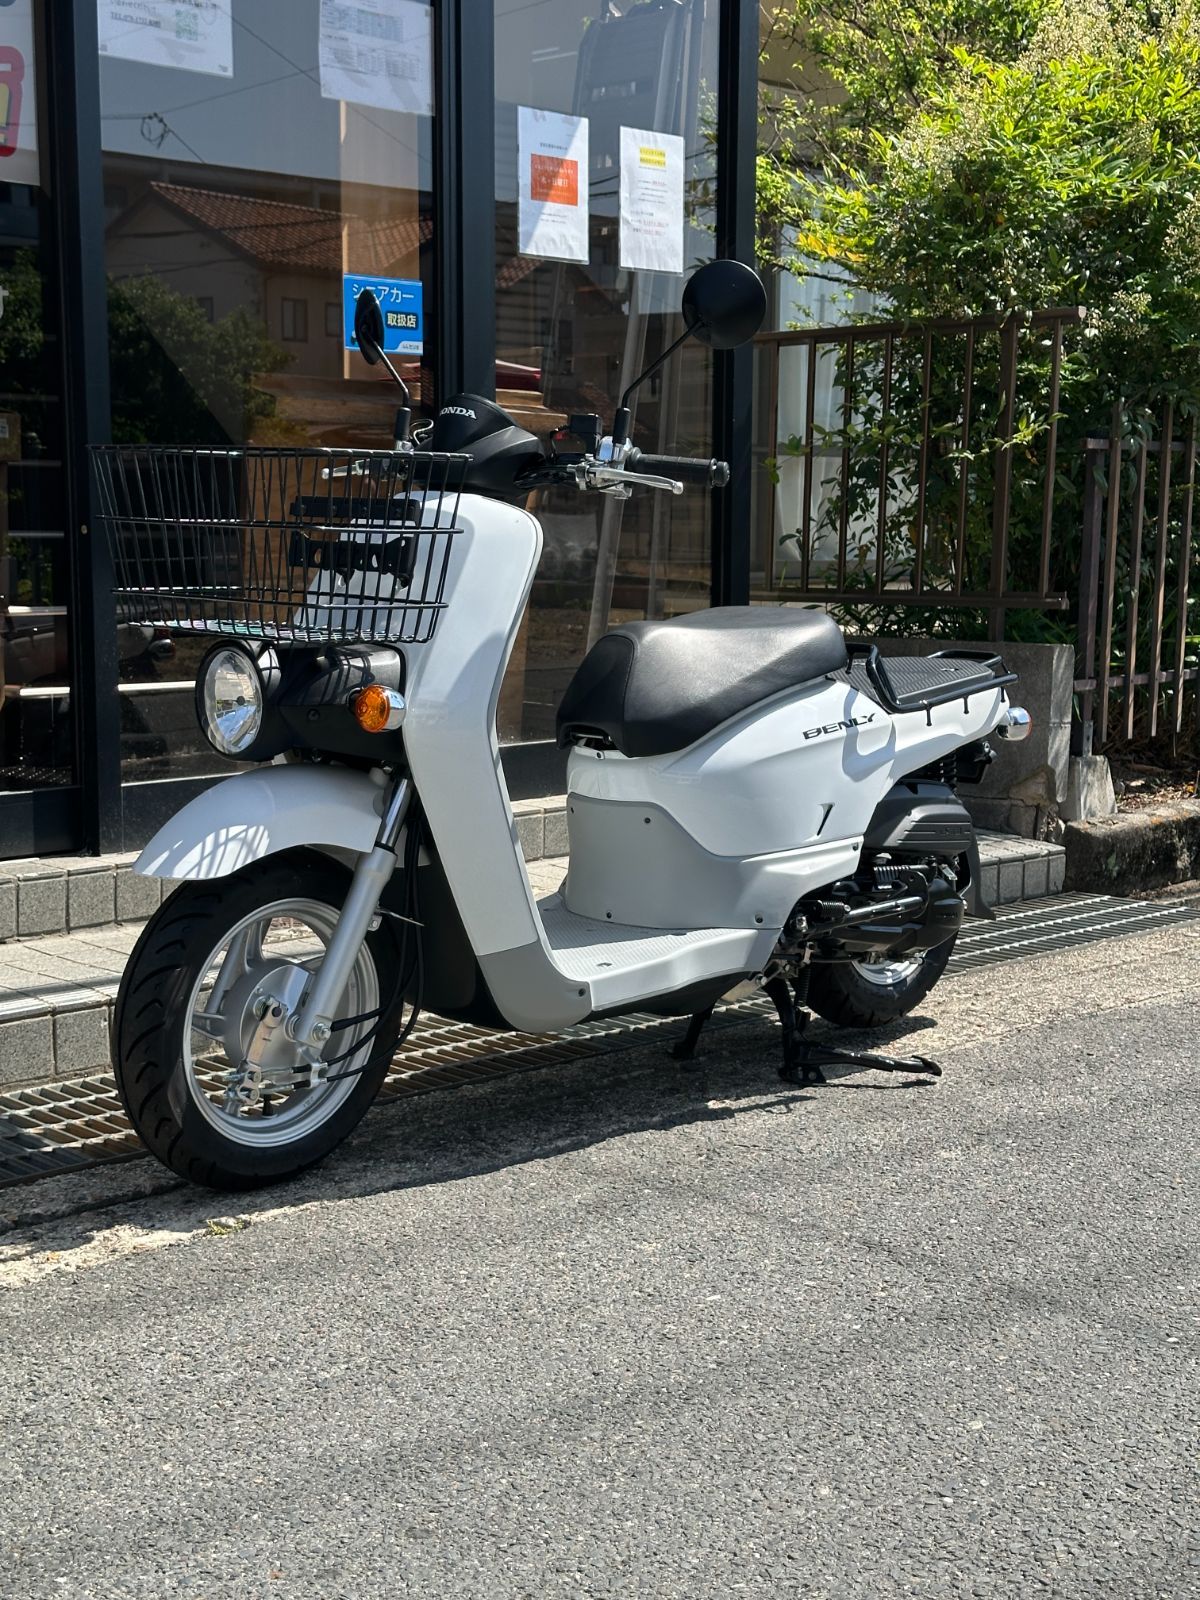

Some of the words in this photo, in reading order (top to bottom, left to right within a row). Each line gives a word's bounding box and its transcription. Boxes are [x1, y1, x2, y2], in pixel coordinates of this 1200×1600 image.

[386, 312, 417, 328] 取扱店
[440, 406, 477, 419] ONDA
[802, 712, 876, 740] BENLY
